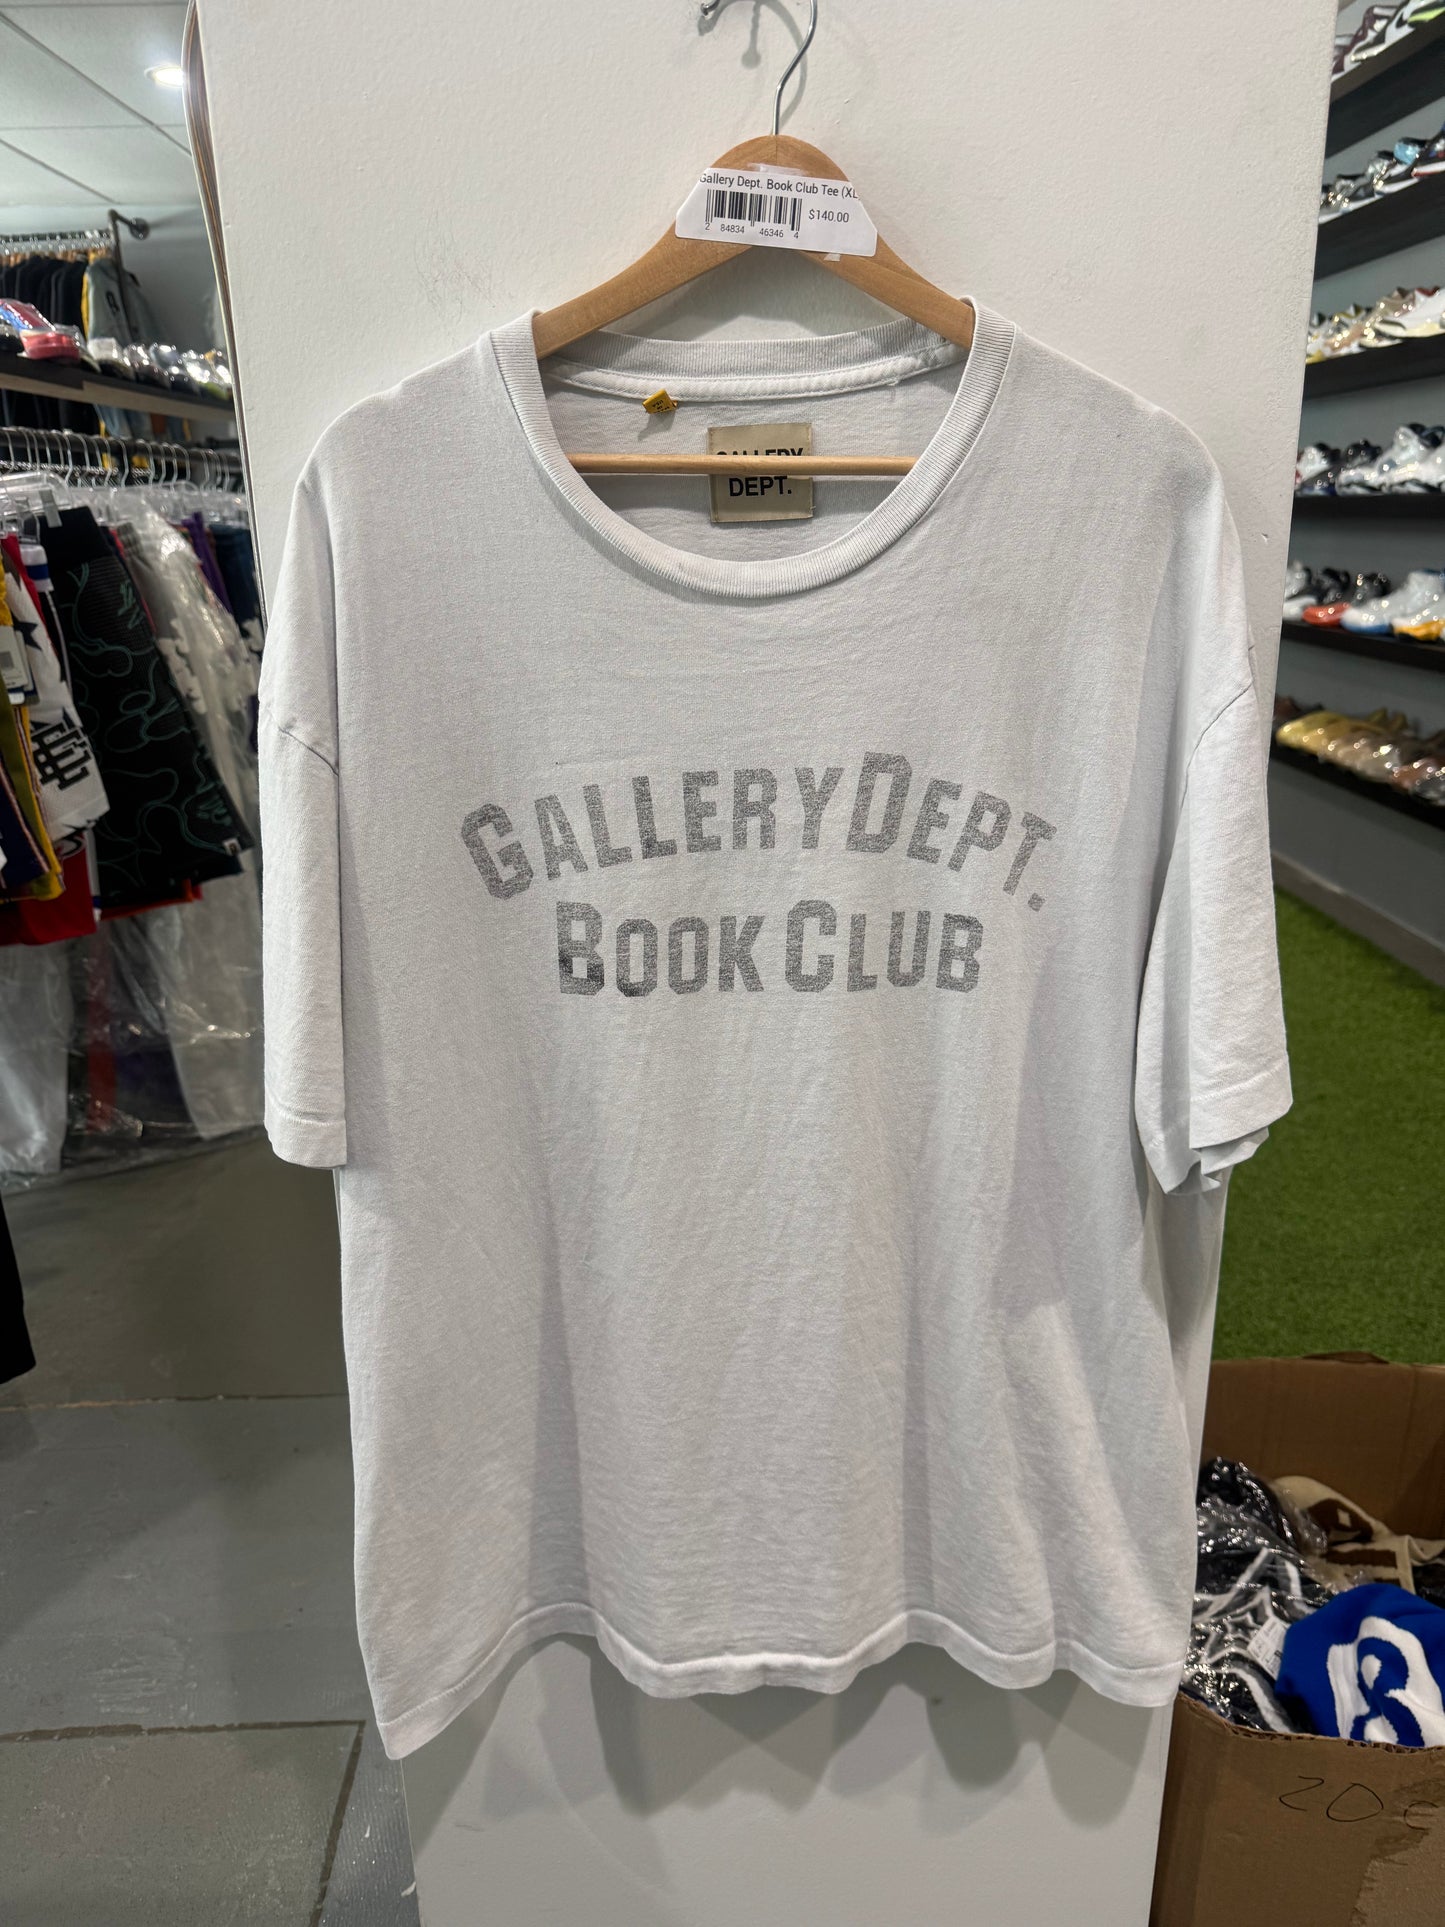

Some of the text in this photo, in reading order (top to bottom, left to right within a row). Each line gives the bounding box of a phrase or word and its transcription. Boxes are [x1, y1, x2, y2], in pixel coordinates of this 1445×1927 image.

[737, 175, 763, 190] Dept.
[766, 178, 793, 192] Book
[795, 181, 818, 195] Club
[821, 184, 839, 197] Tee
[808, 208, 850, 223] $140.00
[705, 223, 799, 239] 2 84834 46346 4
[728, 475, 792, 497] DEPT.
[461, 751, 1057, 911] GALLERY DEPT.
[556, 899, 984, 997] BOOK CLUB
